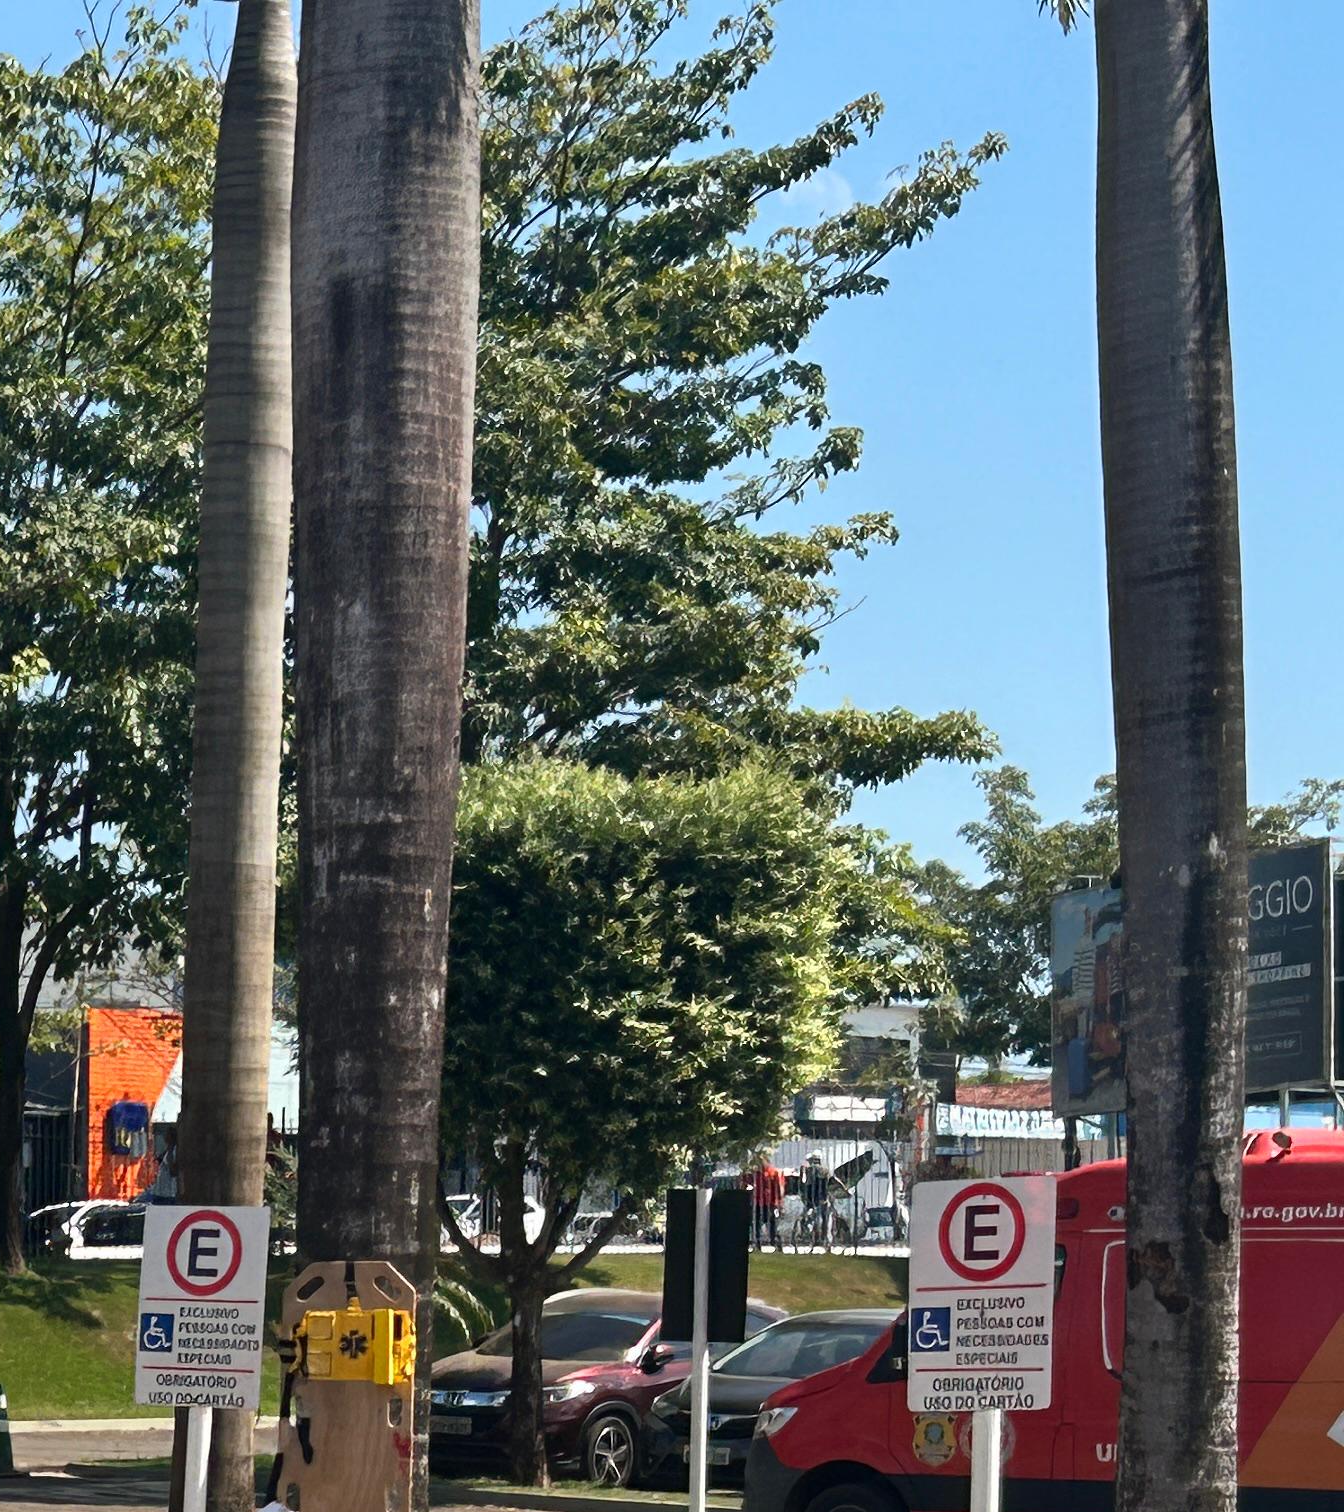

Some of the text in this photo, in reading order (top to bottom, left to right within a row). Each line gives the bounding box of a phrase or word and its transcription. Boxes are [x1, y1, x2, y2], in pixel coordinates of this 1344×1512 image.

[964, 1205, 1000, 1261] E
[187, 1228, 221, 1277] E
[957, 1297, 1025, 1310] EXCLUSIVO
[179, 1306, 239, 1319] EXCLUSIVO
[232, 1323, 256, 1335] COM
[957, 1316, 1045, 1330] PESSOAS COM
[956, 1334, 1049, 1347] NECESSIDADES
[956, 1352, 1018, 1365] ESPECIAIS
[933, 1374, 1024, 1392] OBRIGATÓRIO
[149, 1392, 173, 1404] USO
[176, 1392, 192, 1404] DO
[924, 1396, 952, 1410] USO
[955, 1396, 975, 1409] DO
